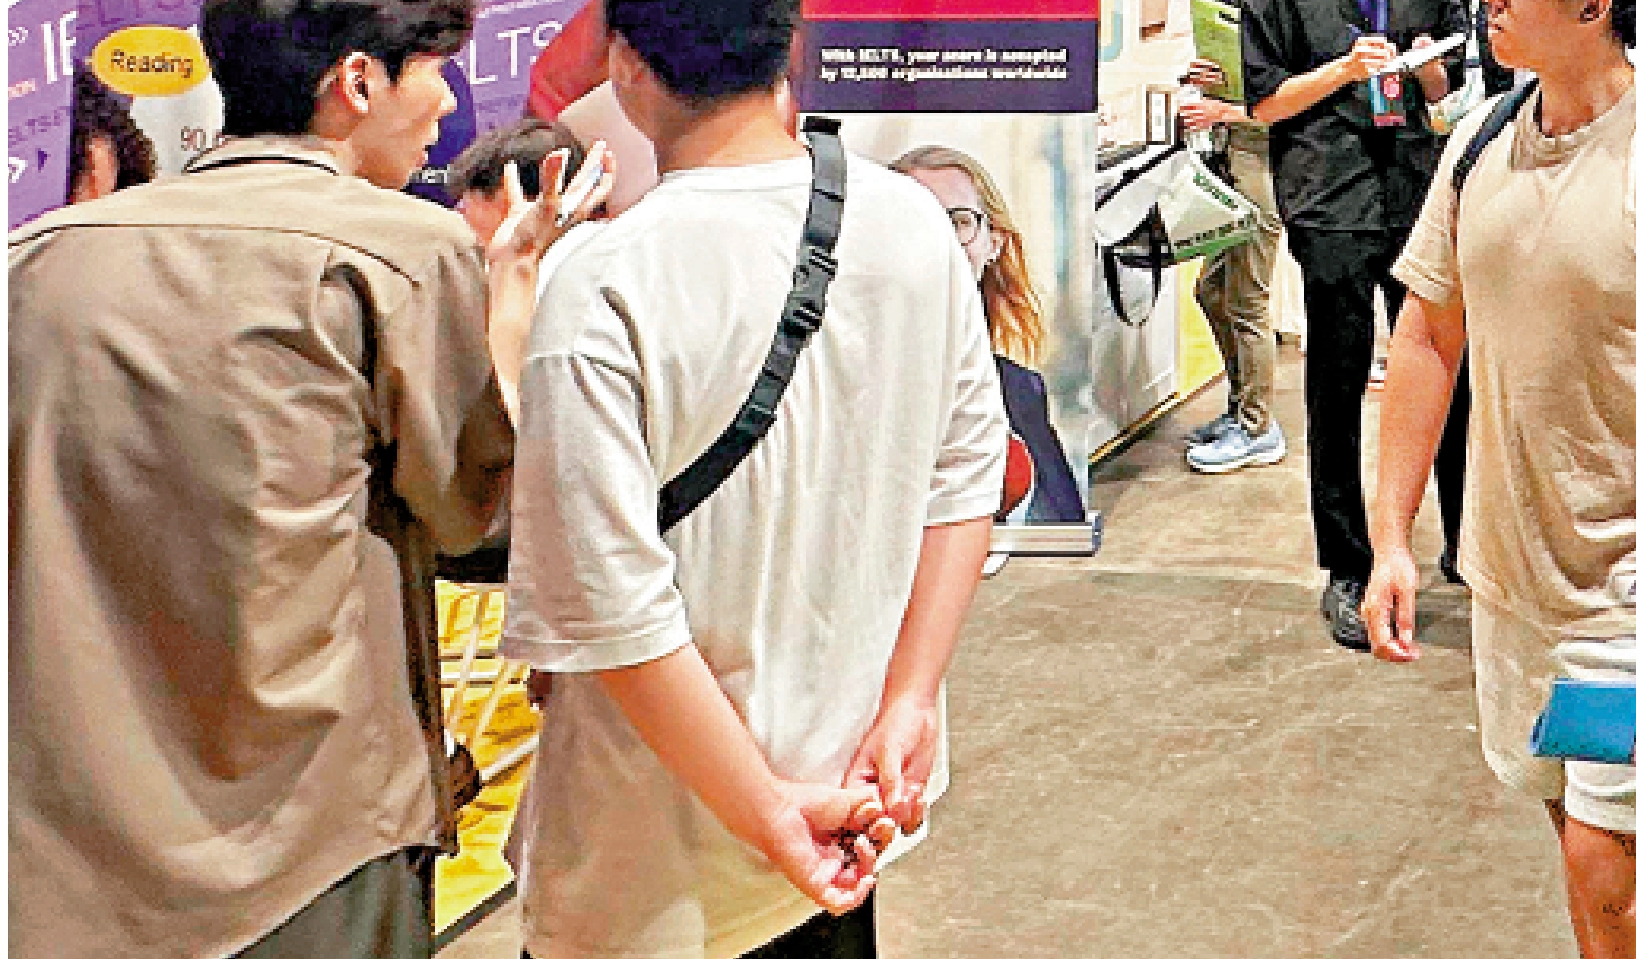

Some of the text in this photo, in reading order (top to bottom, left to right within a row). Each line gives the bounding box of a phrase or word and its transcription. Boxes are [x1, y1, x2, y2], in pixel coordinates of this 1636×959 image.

[110, 49, 194, 79] Reading
[820, 48, 1067, 65] With IELTS, your score is accepted
[820, 66, 838, 82] by
[840, 66, 888, 82] 12,500
[991, 66, 1067, 80] worldwide
